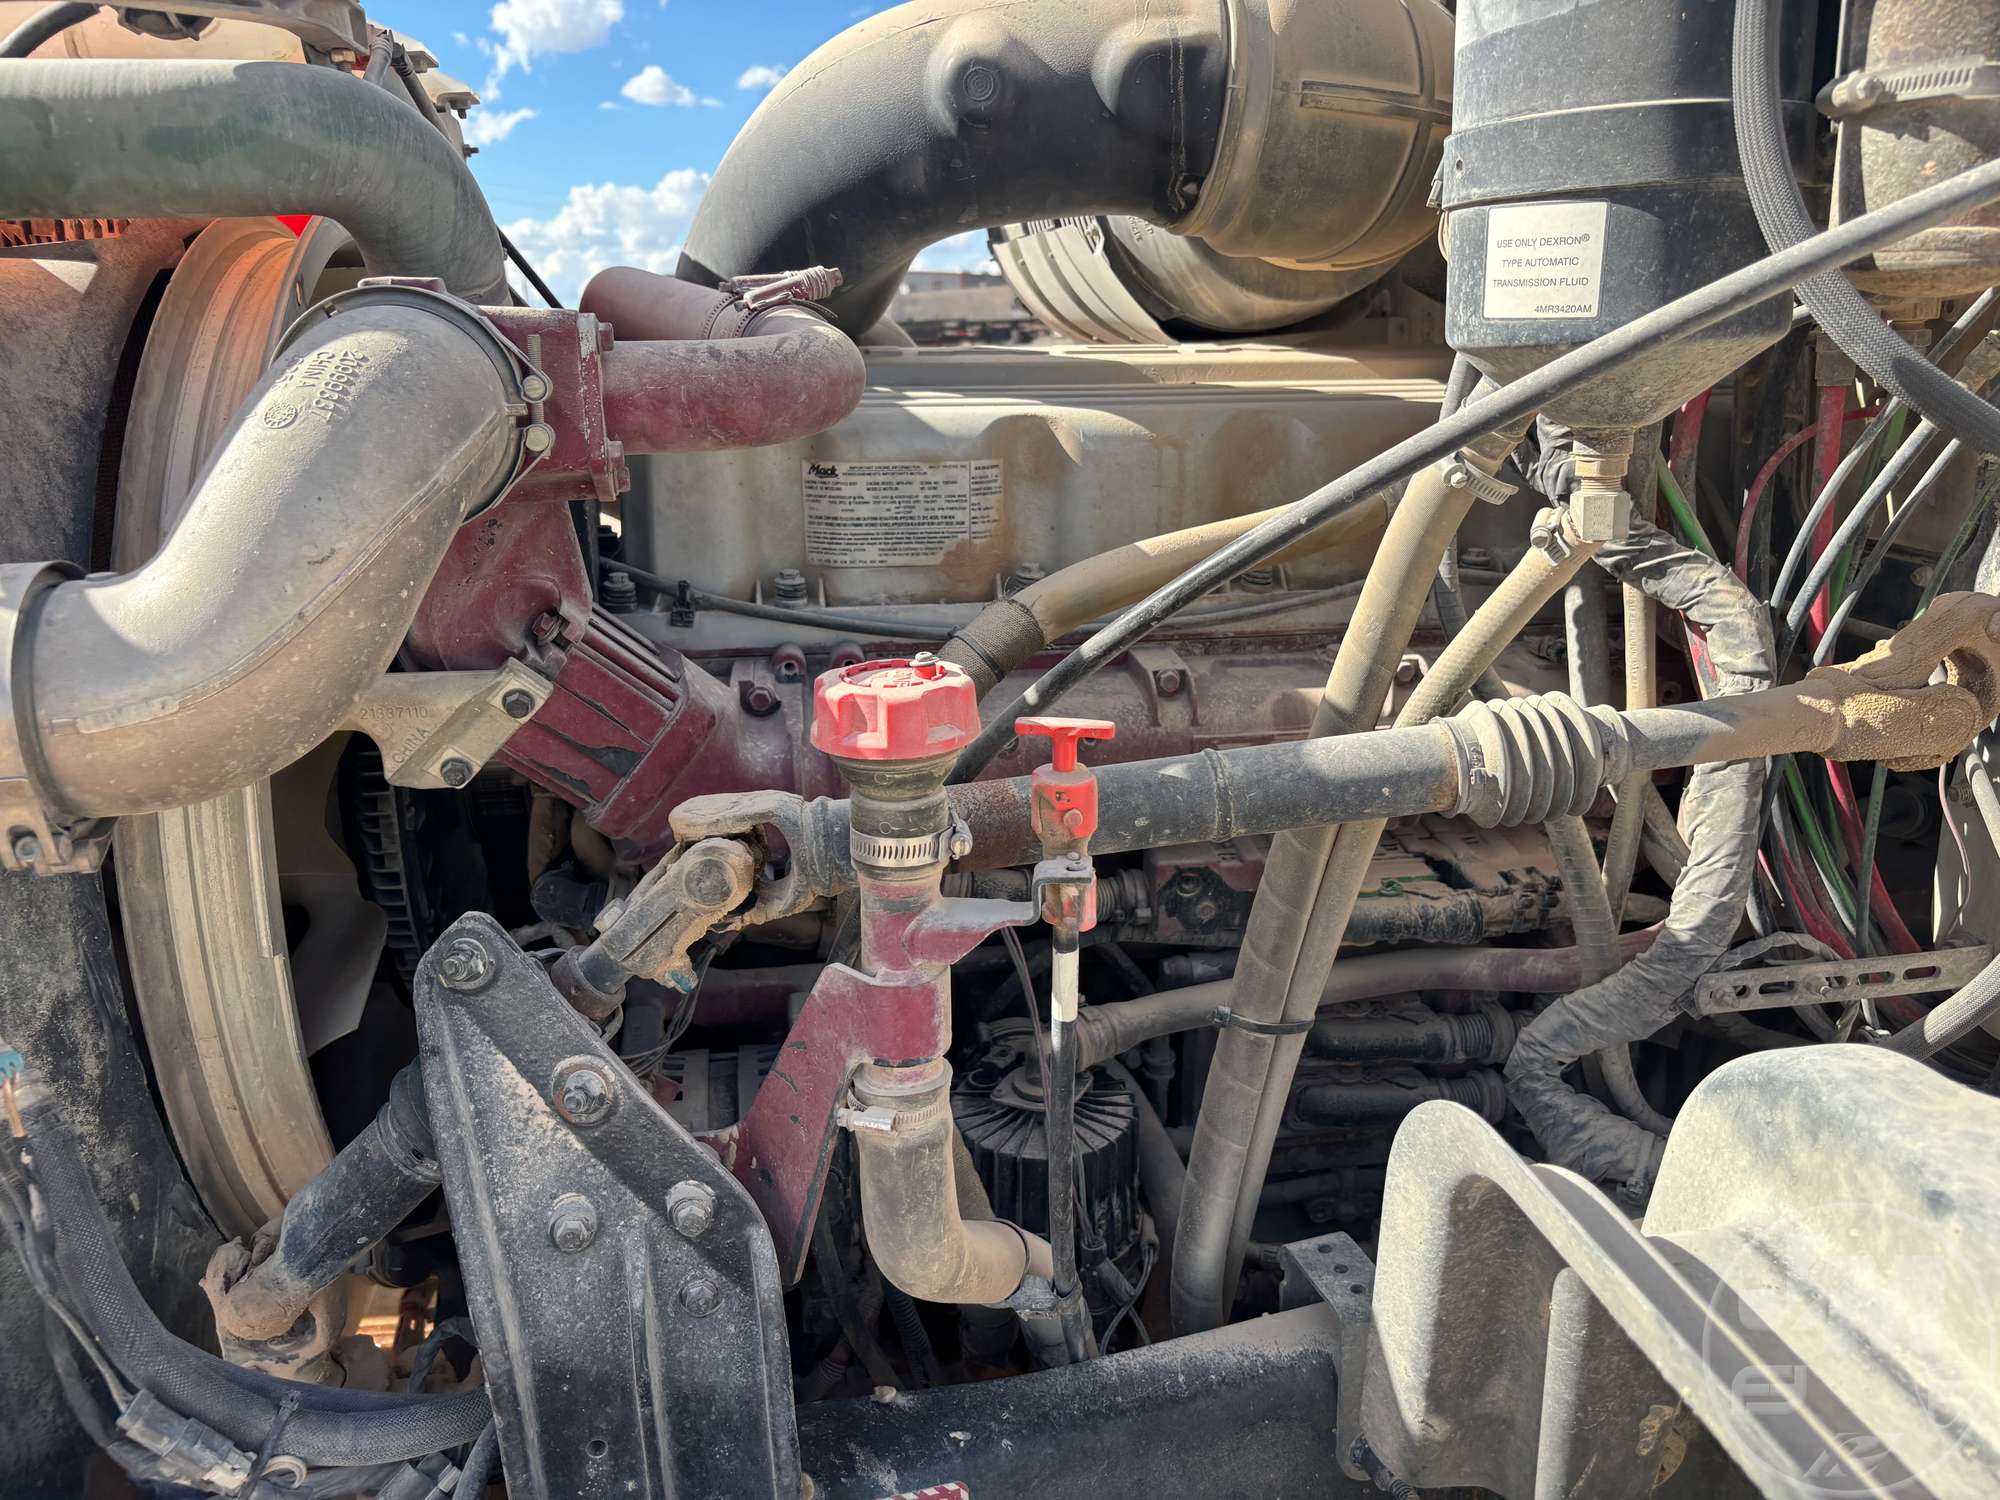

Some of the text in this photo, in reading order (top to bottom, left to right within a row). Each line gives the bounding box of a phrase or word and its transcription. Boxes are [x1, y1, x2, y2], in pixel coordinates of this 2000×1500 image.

[1497, 237, 1513, 248] USE
[1515, 238, 1537, 248] ONLY
[1502, 257, 1580, 268] TYPE AUTOMATIC
[1493, 277, 1589, 288] TRANSMISSION FLUID
[1534, 304, 1592, 313] 4MR3420AM
